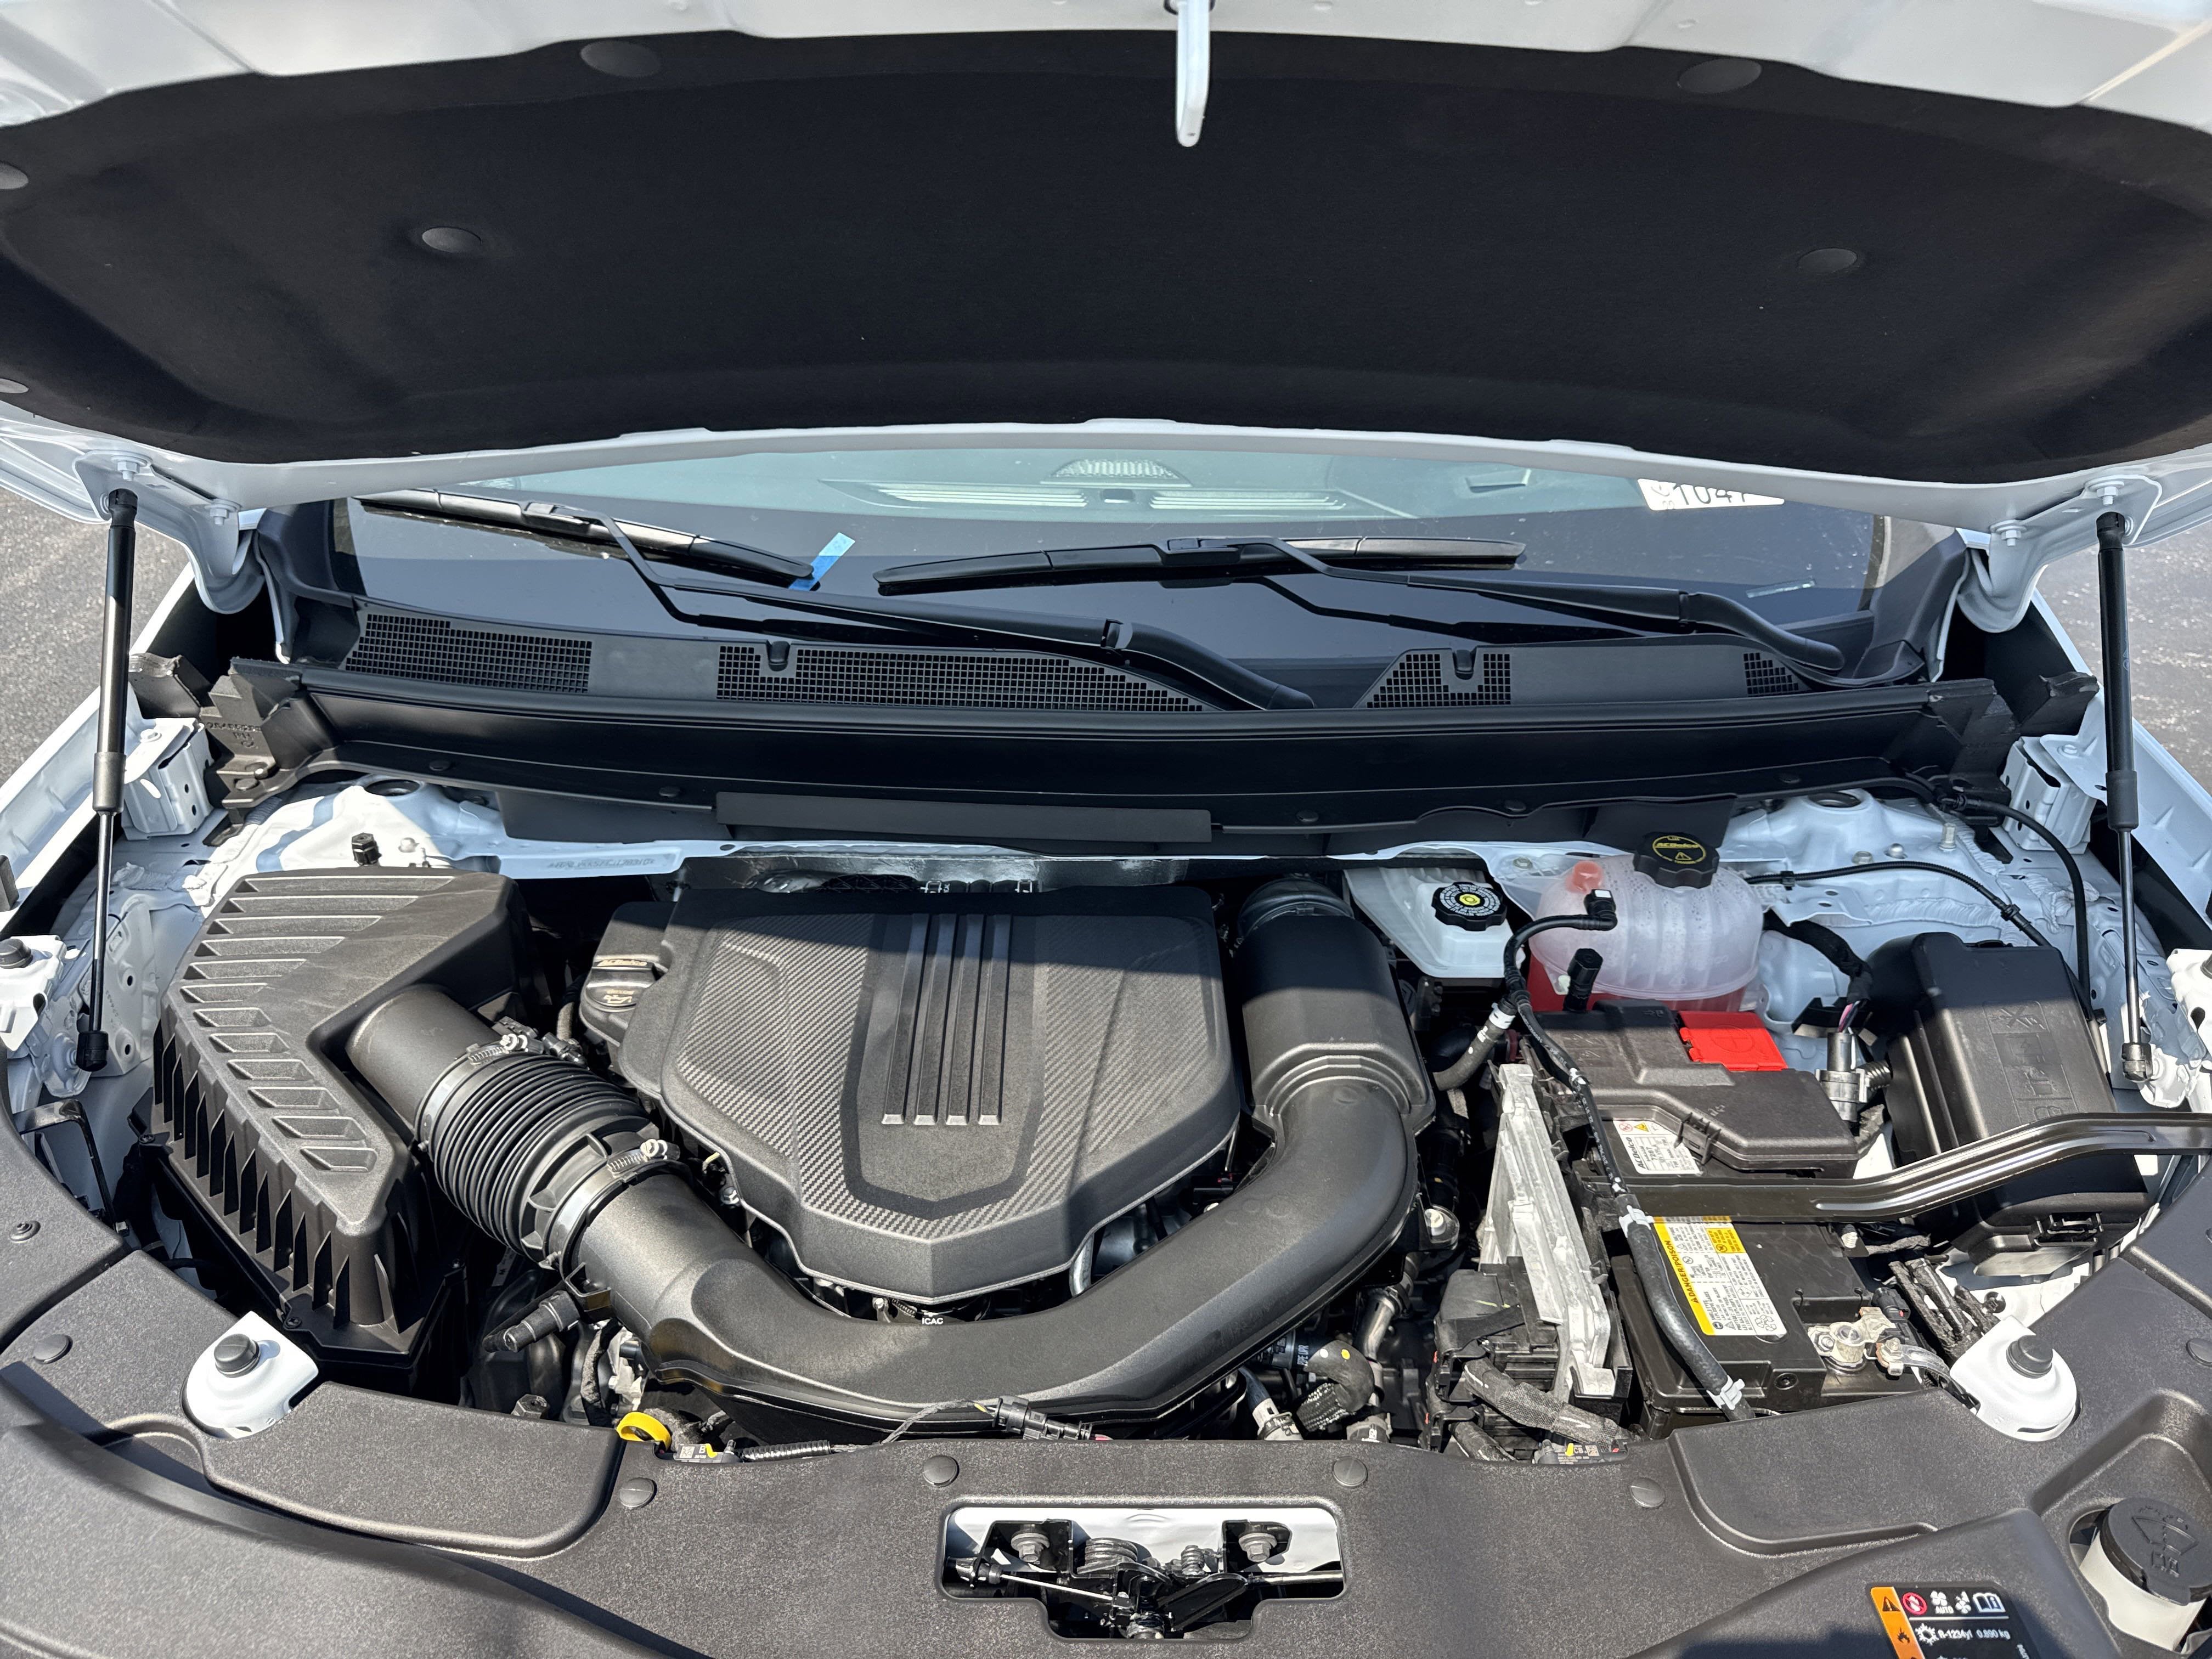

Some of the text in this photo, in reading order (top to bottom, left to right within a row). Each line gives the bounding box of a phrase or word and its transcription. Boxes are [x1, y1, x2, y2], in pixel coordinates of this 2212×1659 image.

[1626, 1137, 1646, 1169] ACDelco
[1664, 1240, 1696, 1296] DANGER/POISON
[1935, 1606, 1954, 1614] AUTO
